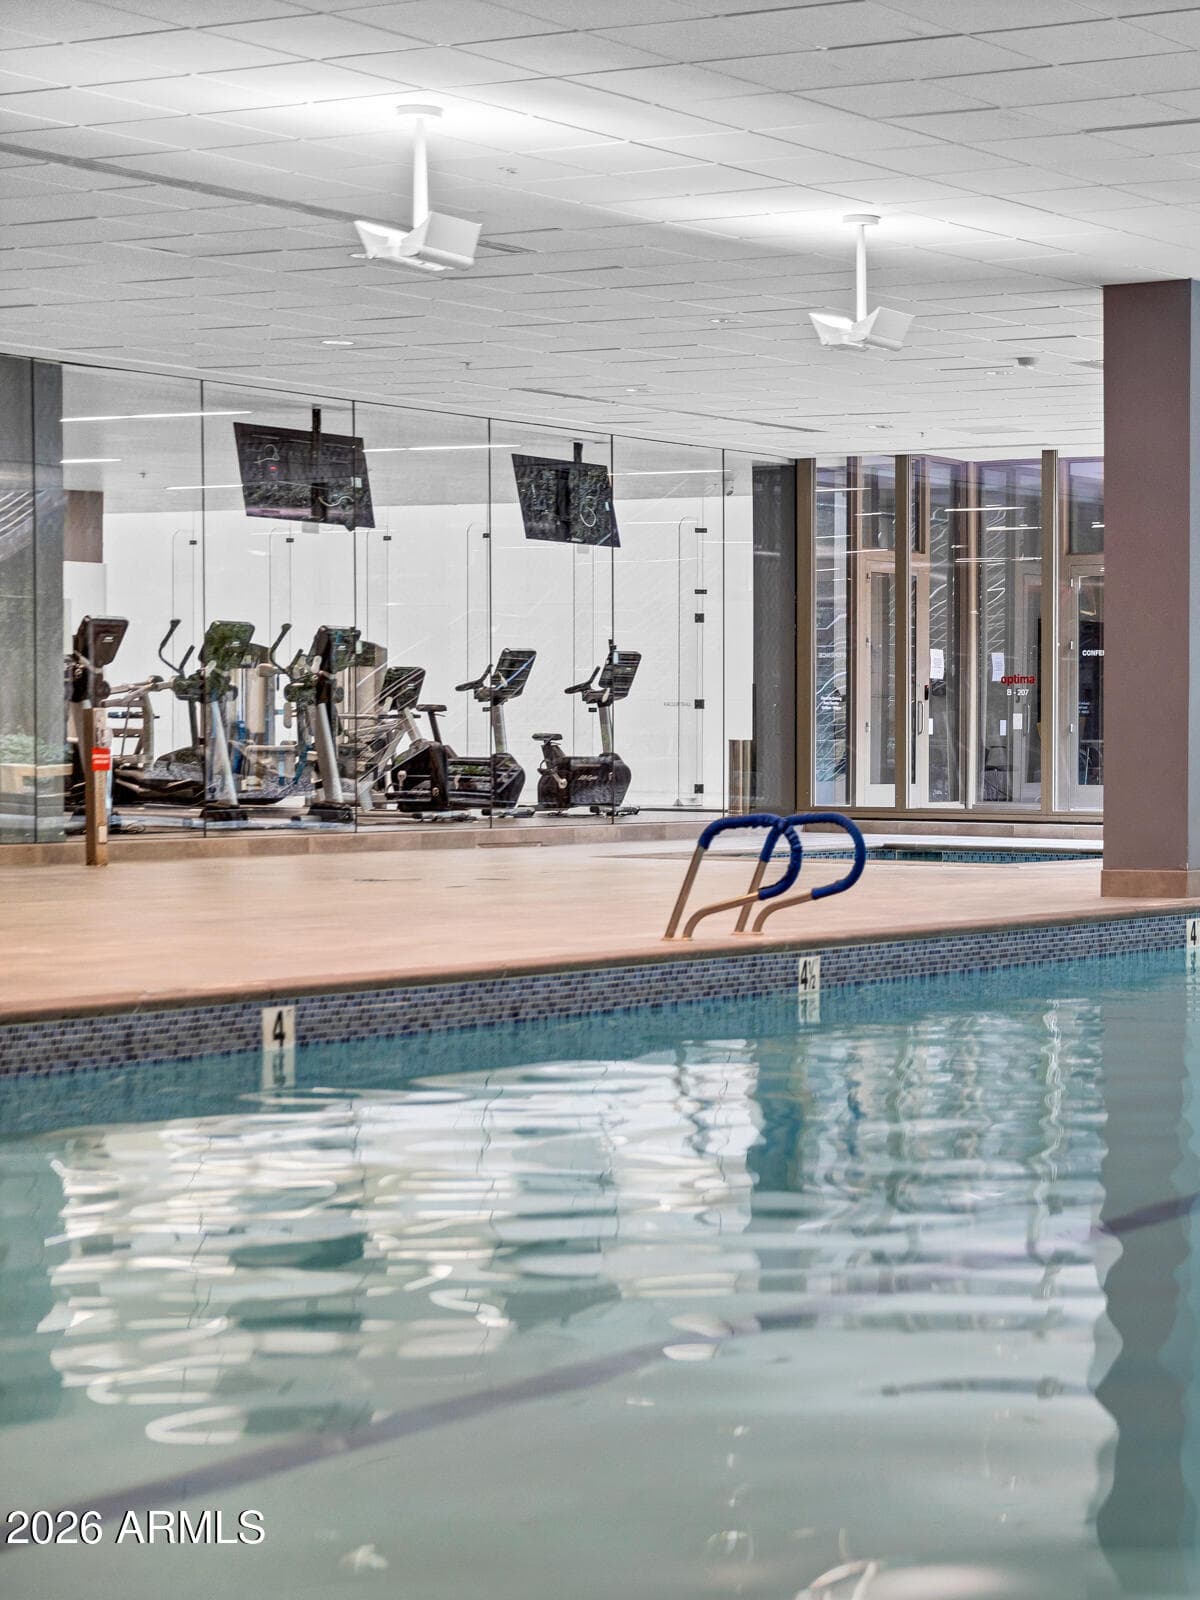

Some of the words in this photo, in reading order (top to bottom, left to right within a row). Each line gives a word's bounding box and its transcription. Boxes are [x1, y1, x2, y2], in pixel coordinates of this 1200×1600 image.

[1001, 674, 1036, 687] optima
[1006, 688, 1012, 696] B
[1017, 688, 1030, 696] 207
[1190, 920, 1198, 947] 4
[272, 1010, 286, 1048] 4
